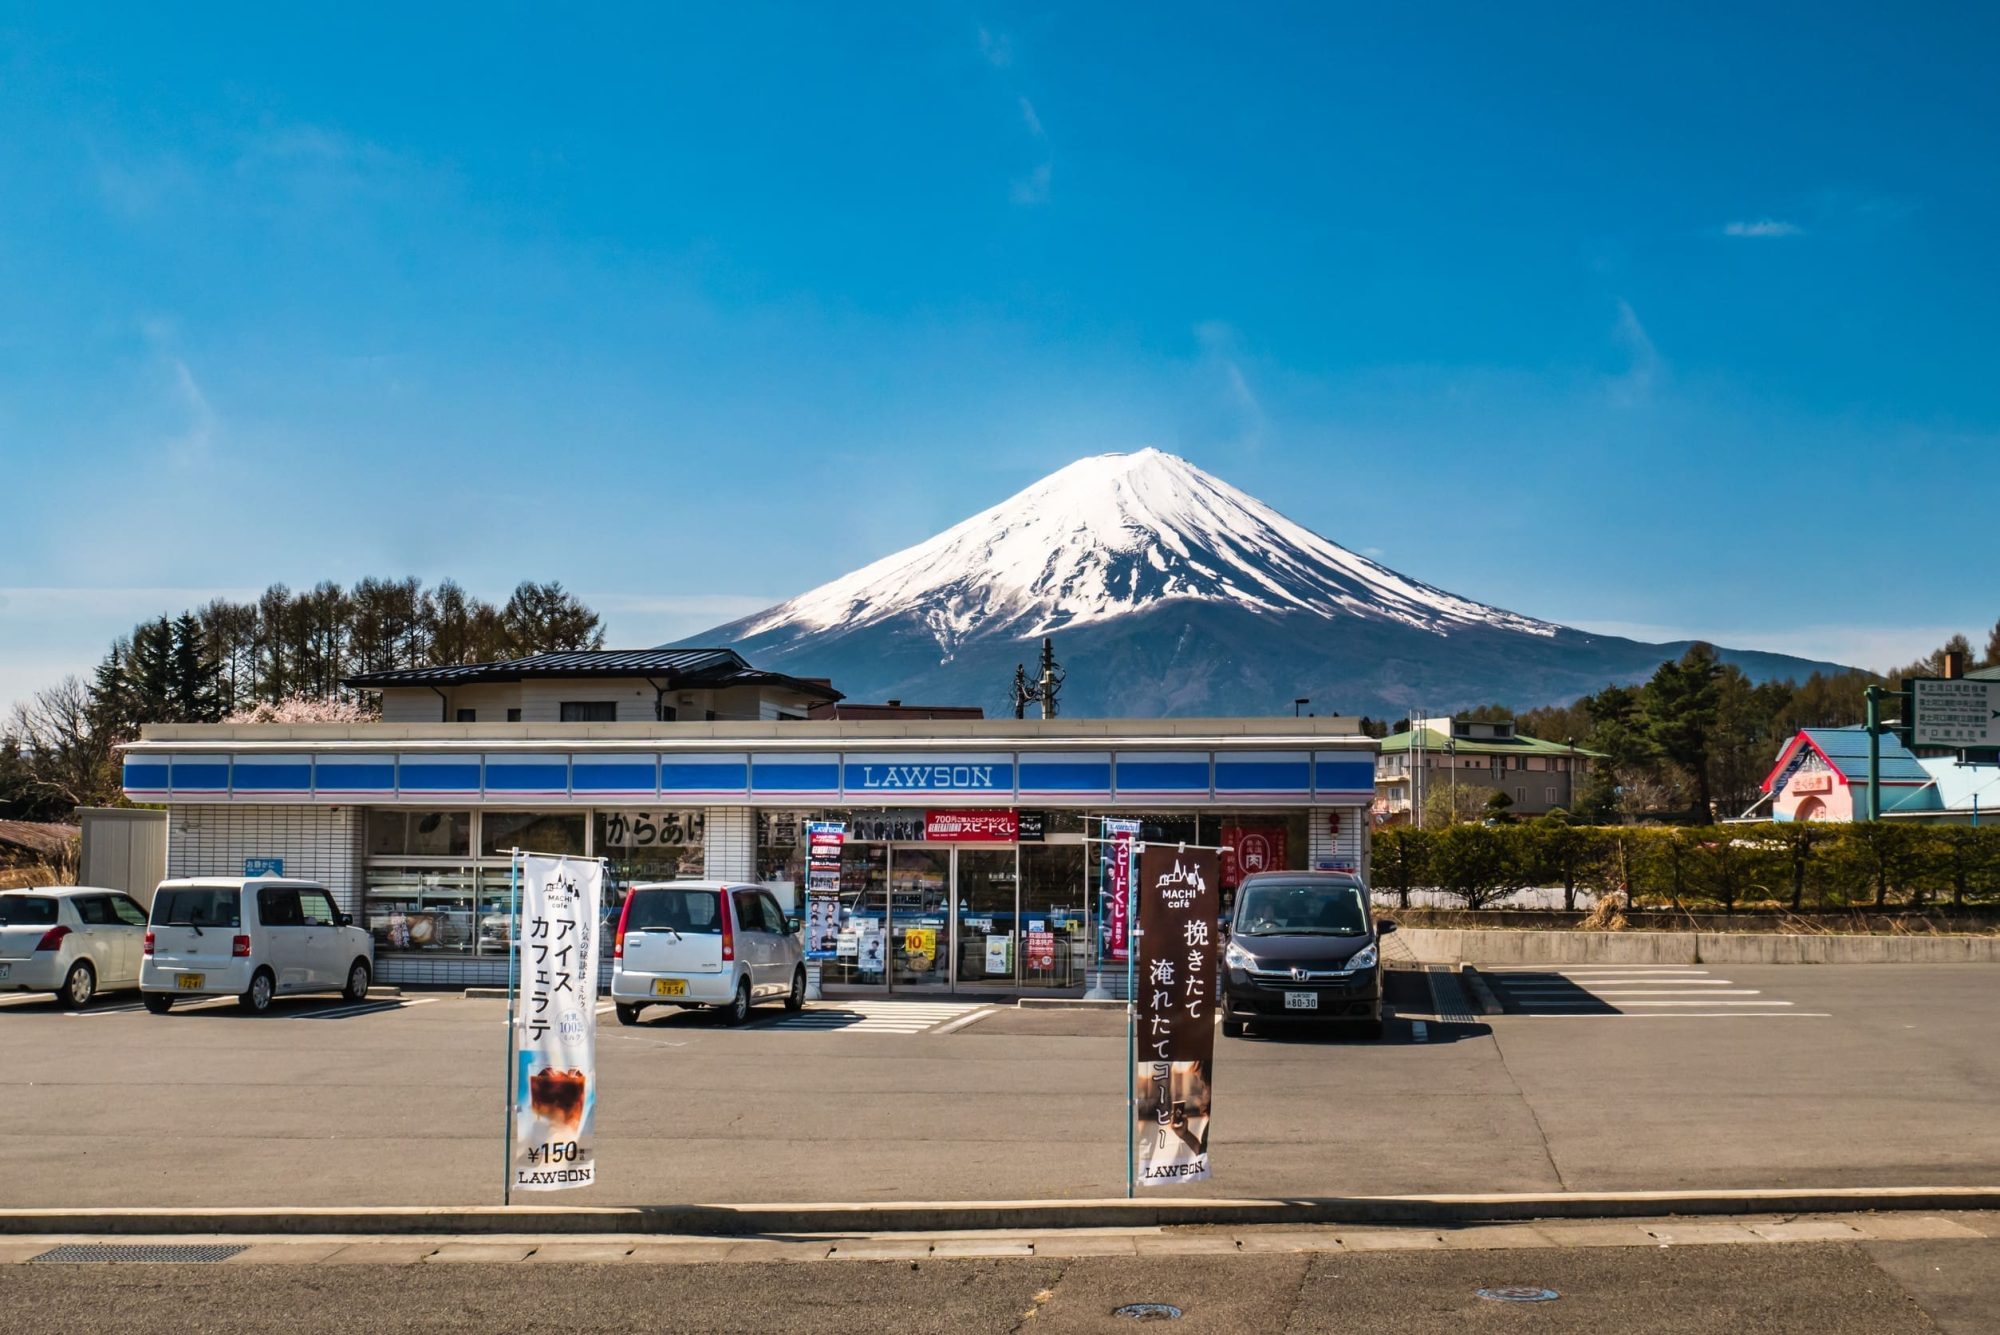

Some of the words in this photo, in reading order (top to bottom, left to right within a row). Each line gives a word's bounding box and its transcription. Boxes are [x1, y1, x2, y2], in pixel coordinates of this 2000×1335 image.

[864, 767, 992, 787] LAWSON
[812, 826, 844, 834] LAWSON
[962, 822, 1016, 833] スピードくじ
[1114, 837, 1129, 918] スピードくじ
[548, 894, 573, 903] MACHI
[1162, 889, 1197, 899] MACHI
[1167, 899, 1191, 909] café
[907, 936, 922, 949] 10
[553, 918, 577, 993] アイス
[1183, 919, 1210, 1019] 挽きたて
[529, 915, 552, 1042] カフェラテ
[1150, 958, 1176, 1150] 淹れたてコーヒー
[528, 1141, 578, 1164] ¥150
[518, 1168, 591, 1185] LAWSON
[1145, 1161, 1206, 1179] LAWSON
